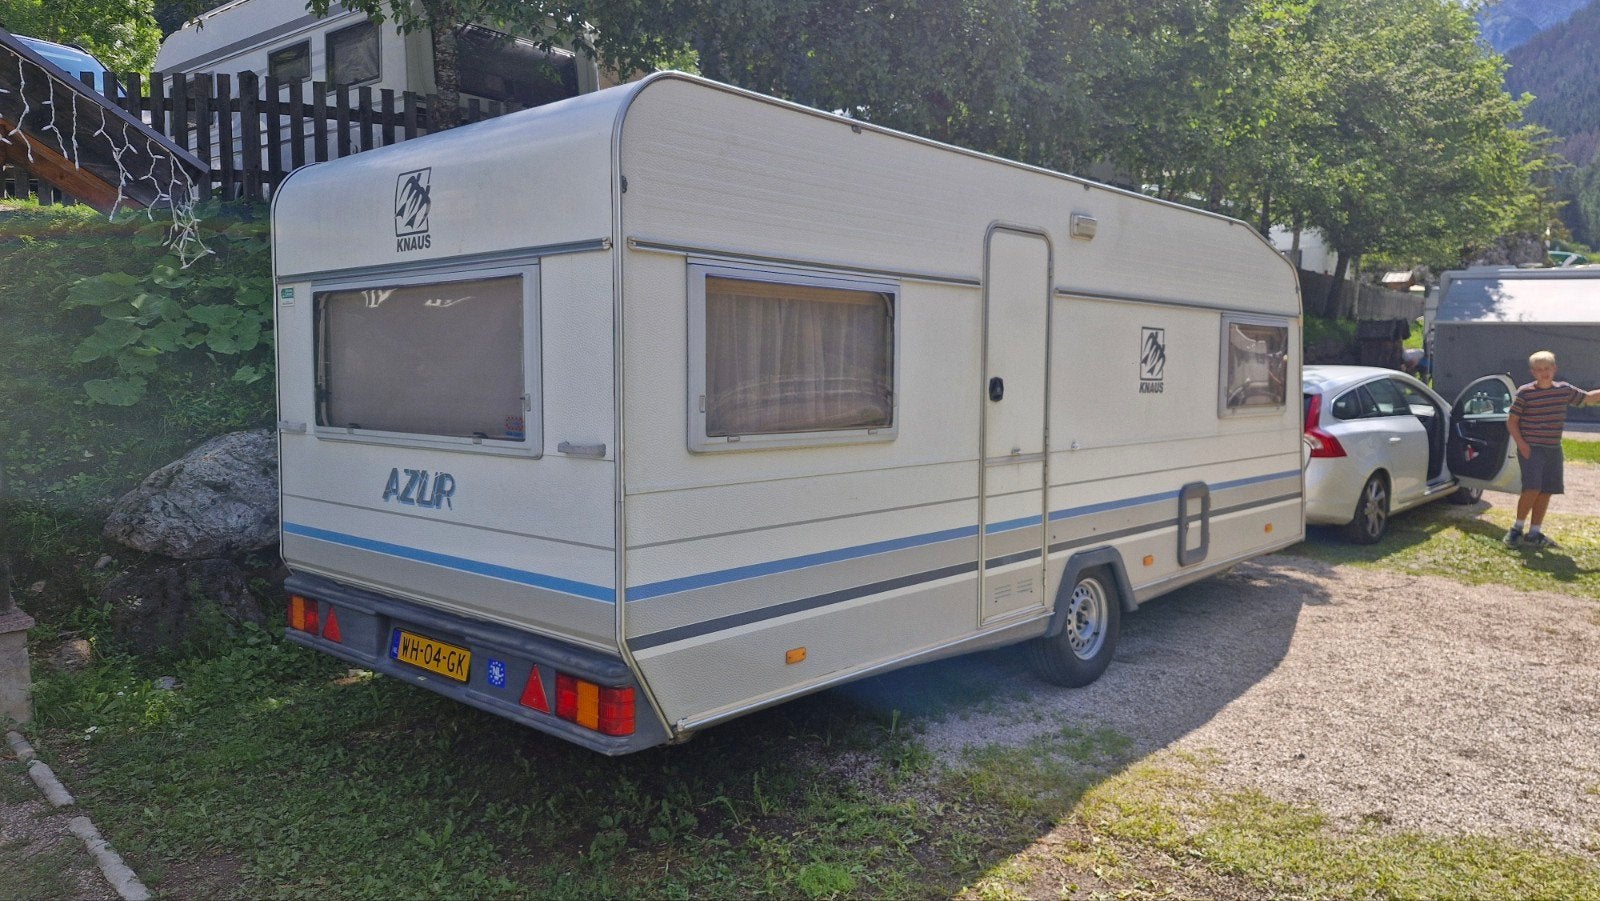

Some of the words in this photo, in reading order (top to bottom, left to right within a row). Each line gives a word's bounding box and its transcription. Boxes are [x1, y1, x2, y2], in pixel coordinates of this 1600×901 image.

[397, 234, 431, 252] KNAUS
[1139, 382, 1164, 394] KNAUS
[382, 467, 457, 511] AZUR
[402, 636, 466, 676] WH-04-GK
